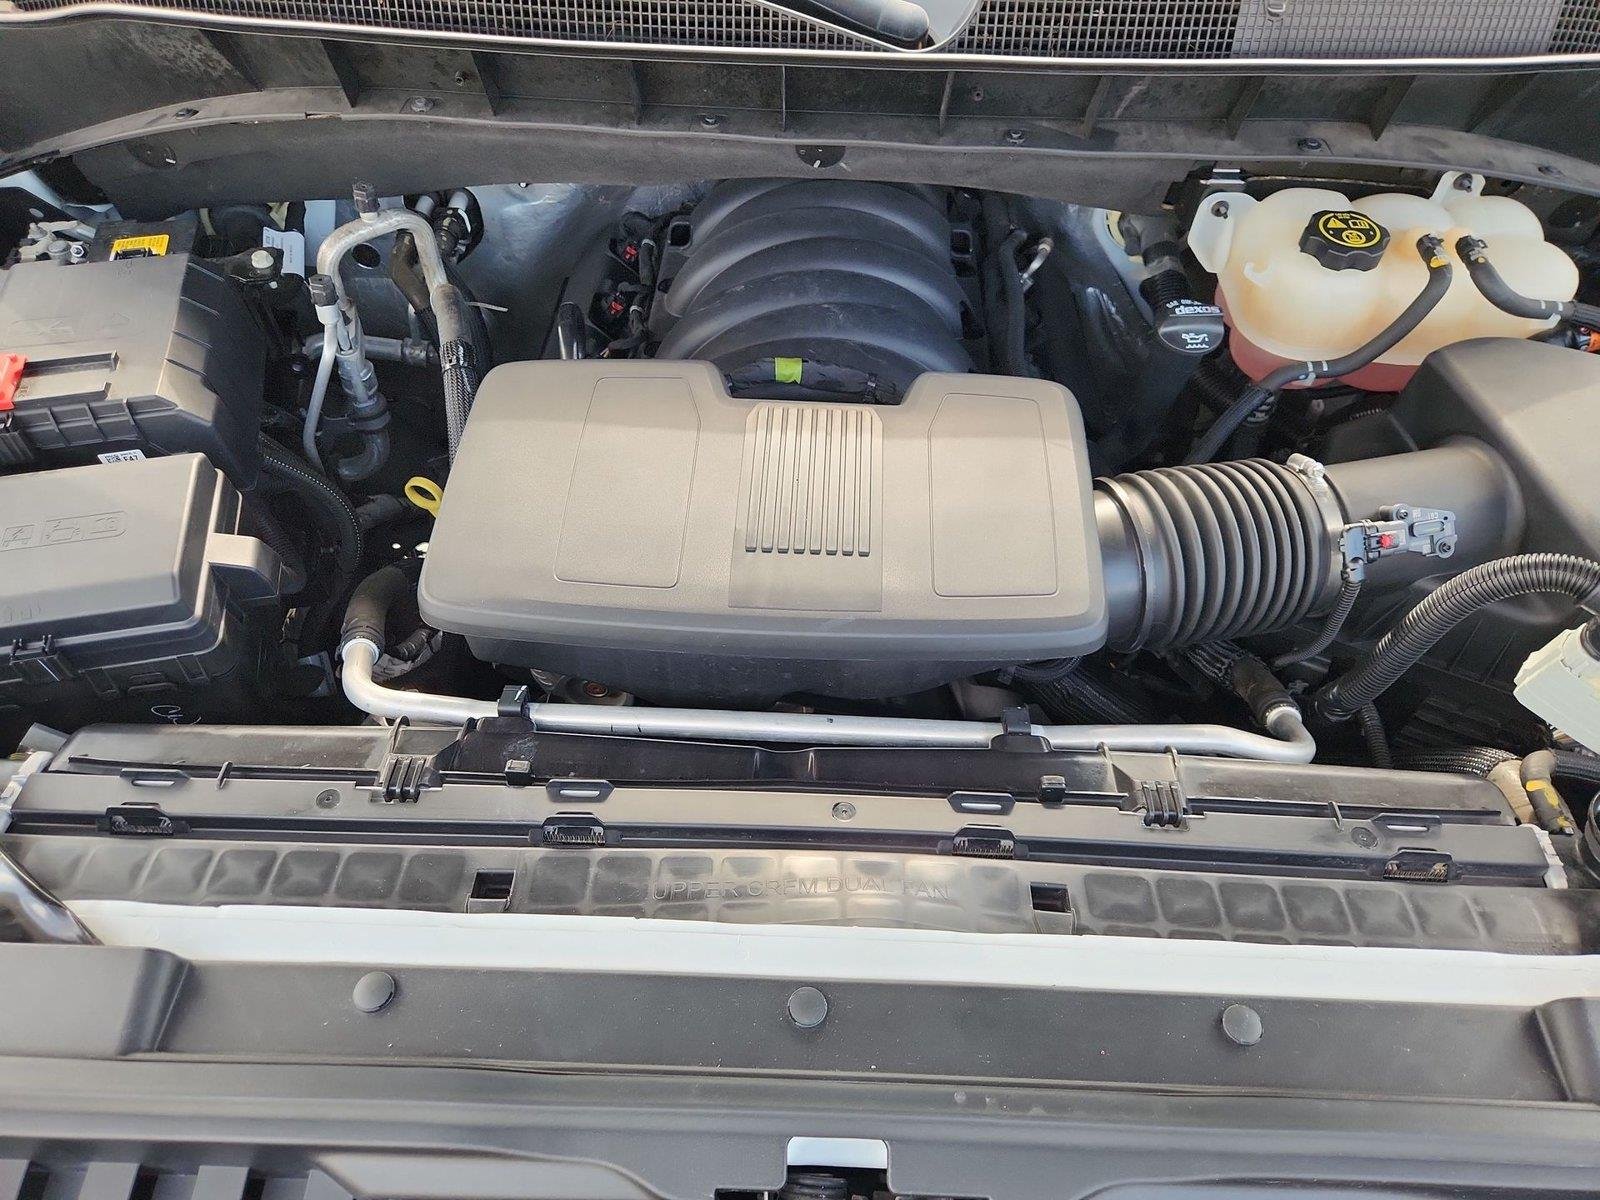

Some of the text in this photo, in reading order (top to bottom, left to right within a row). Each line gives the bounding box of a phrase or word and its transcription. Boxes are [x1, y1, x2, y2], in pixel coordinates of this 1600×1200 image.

[1175, 305, 1221, 314] dexos
[652, 880, 740, 900] UPPER
[828, 876, 894, 893] DUAL
[902, 880, 951, 901] FAN
